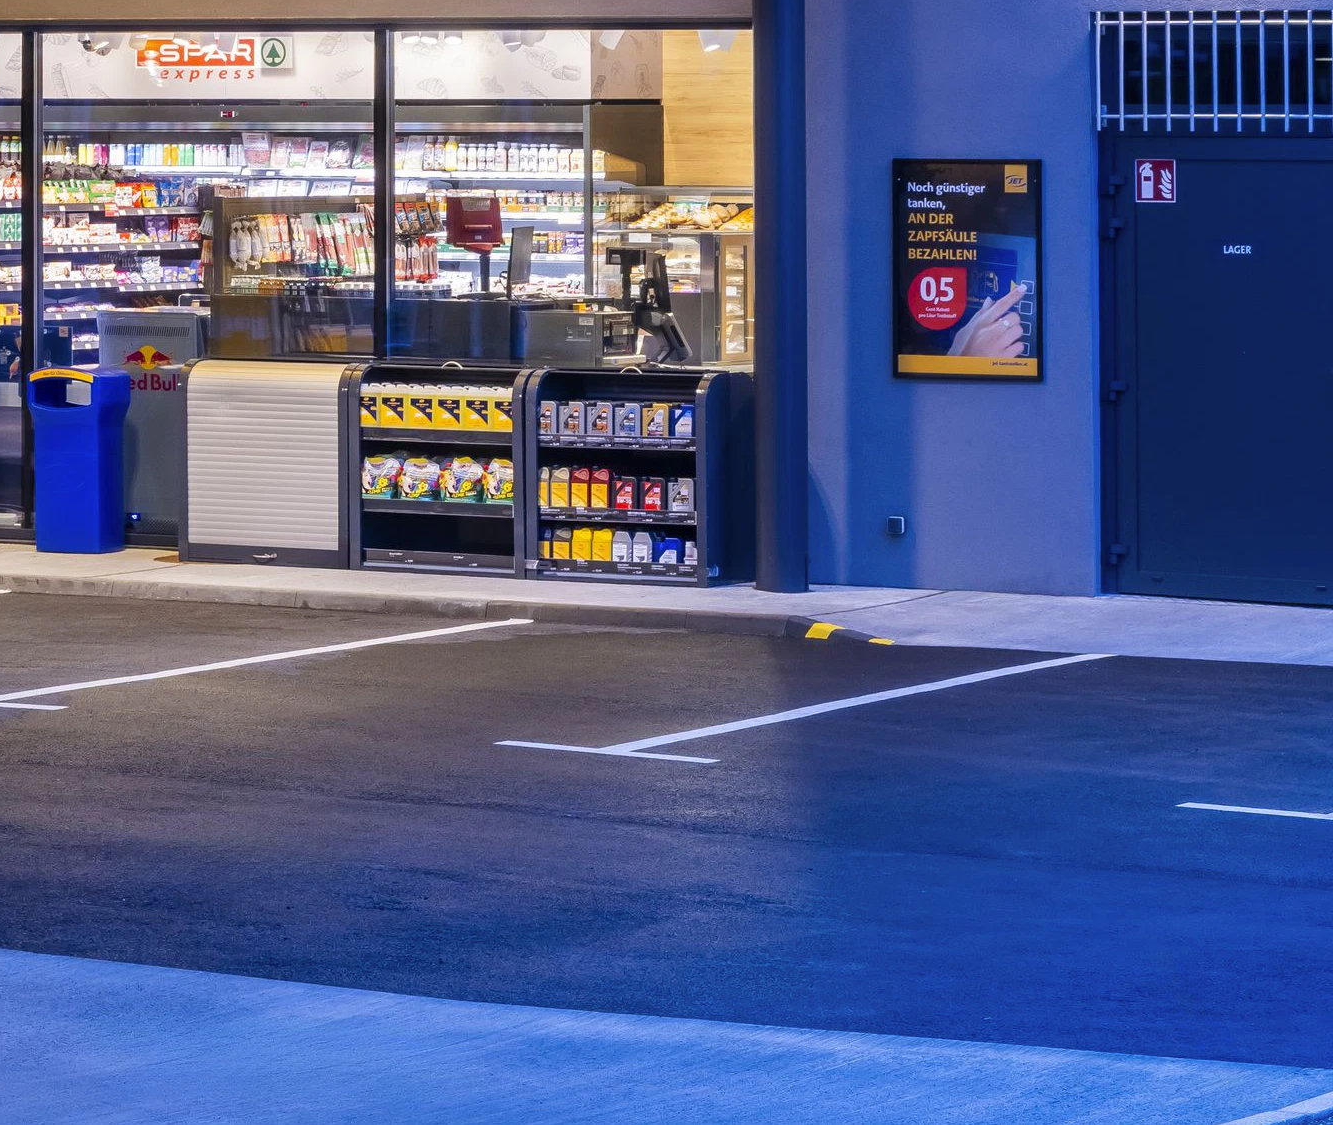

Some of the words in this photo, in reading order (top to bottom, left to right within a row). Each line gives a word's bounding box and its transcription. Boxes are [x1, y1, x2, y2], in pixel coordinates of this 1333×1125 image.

[159, 43, 251, 62] SPAR
[160, 68, 255, 83] express
[1009, 177, 1023, 185] JET
[907, 182, 934, 192] Noch
[935, 182, 986, 196] günstiger
[907, 197, 946, 210] tanken,
[908, 213, 926, 224] AN
[929, 213, 954, 225] DER
[908, 228, 978, 243] ZAPFSÄULE
[908, 248, 978, 261] BEZAHLEN!
[1223, 245, 1252, 255] LAGER
[920, 276, 954, 305] 0,5
[130, 374, 148, 391] ed
[151, 374, 181, 391] Bul
